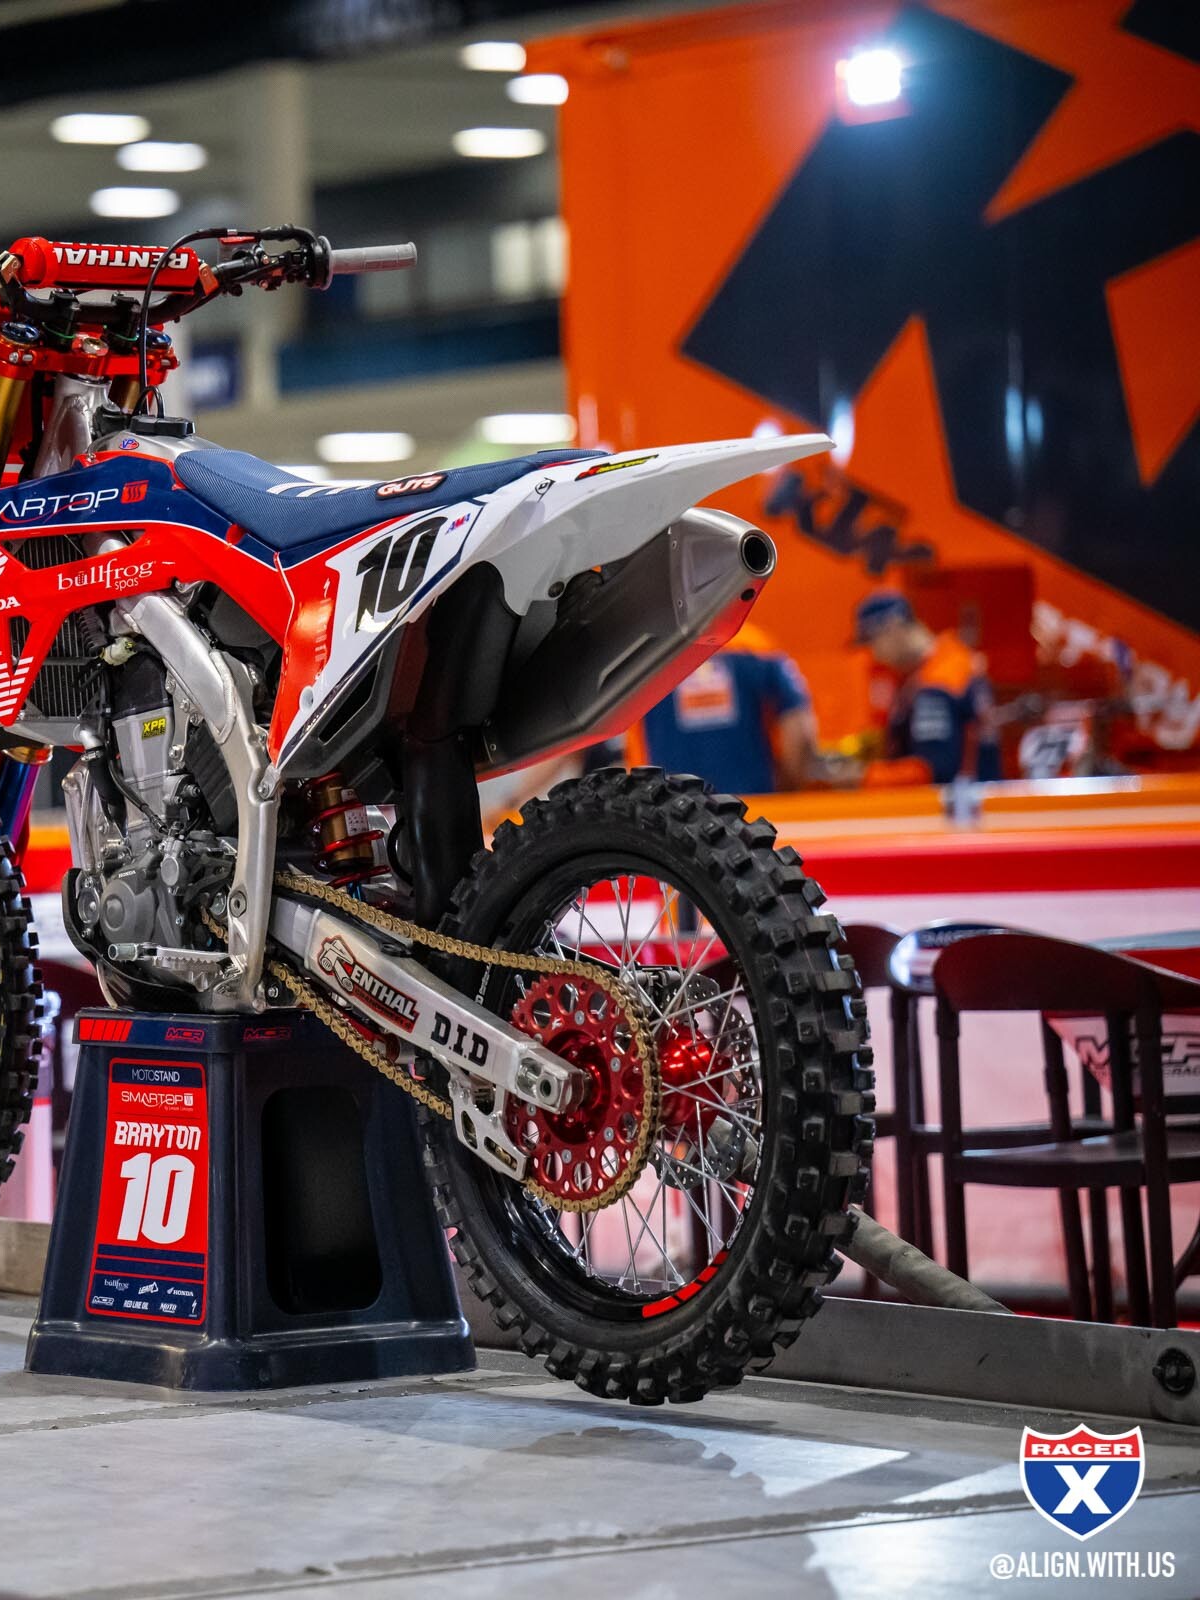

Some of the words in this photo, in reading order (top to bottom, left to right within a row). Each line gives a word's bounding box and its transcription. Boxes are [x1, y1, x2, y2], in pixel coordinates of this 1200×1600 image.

[57, 558, 154, 591] bullfrog
[114, 577, 140, 592] spas
[356, 516, 448, 633] 10
[164, 1026, 205, 1043] MCR
[131, 1068, 180, 1083] MOTOSTAND
[121, 1090, 184, 1108] SMARTOP
[114, 1120, 202, 1151] BRAYTON
[117, 1152, 196, 1245] 10
